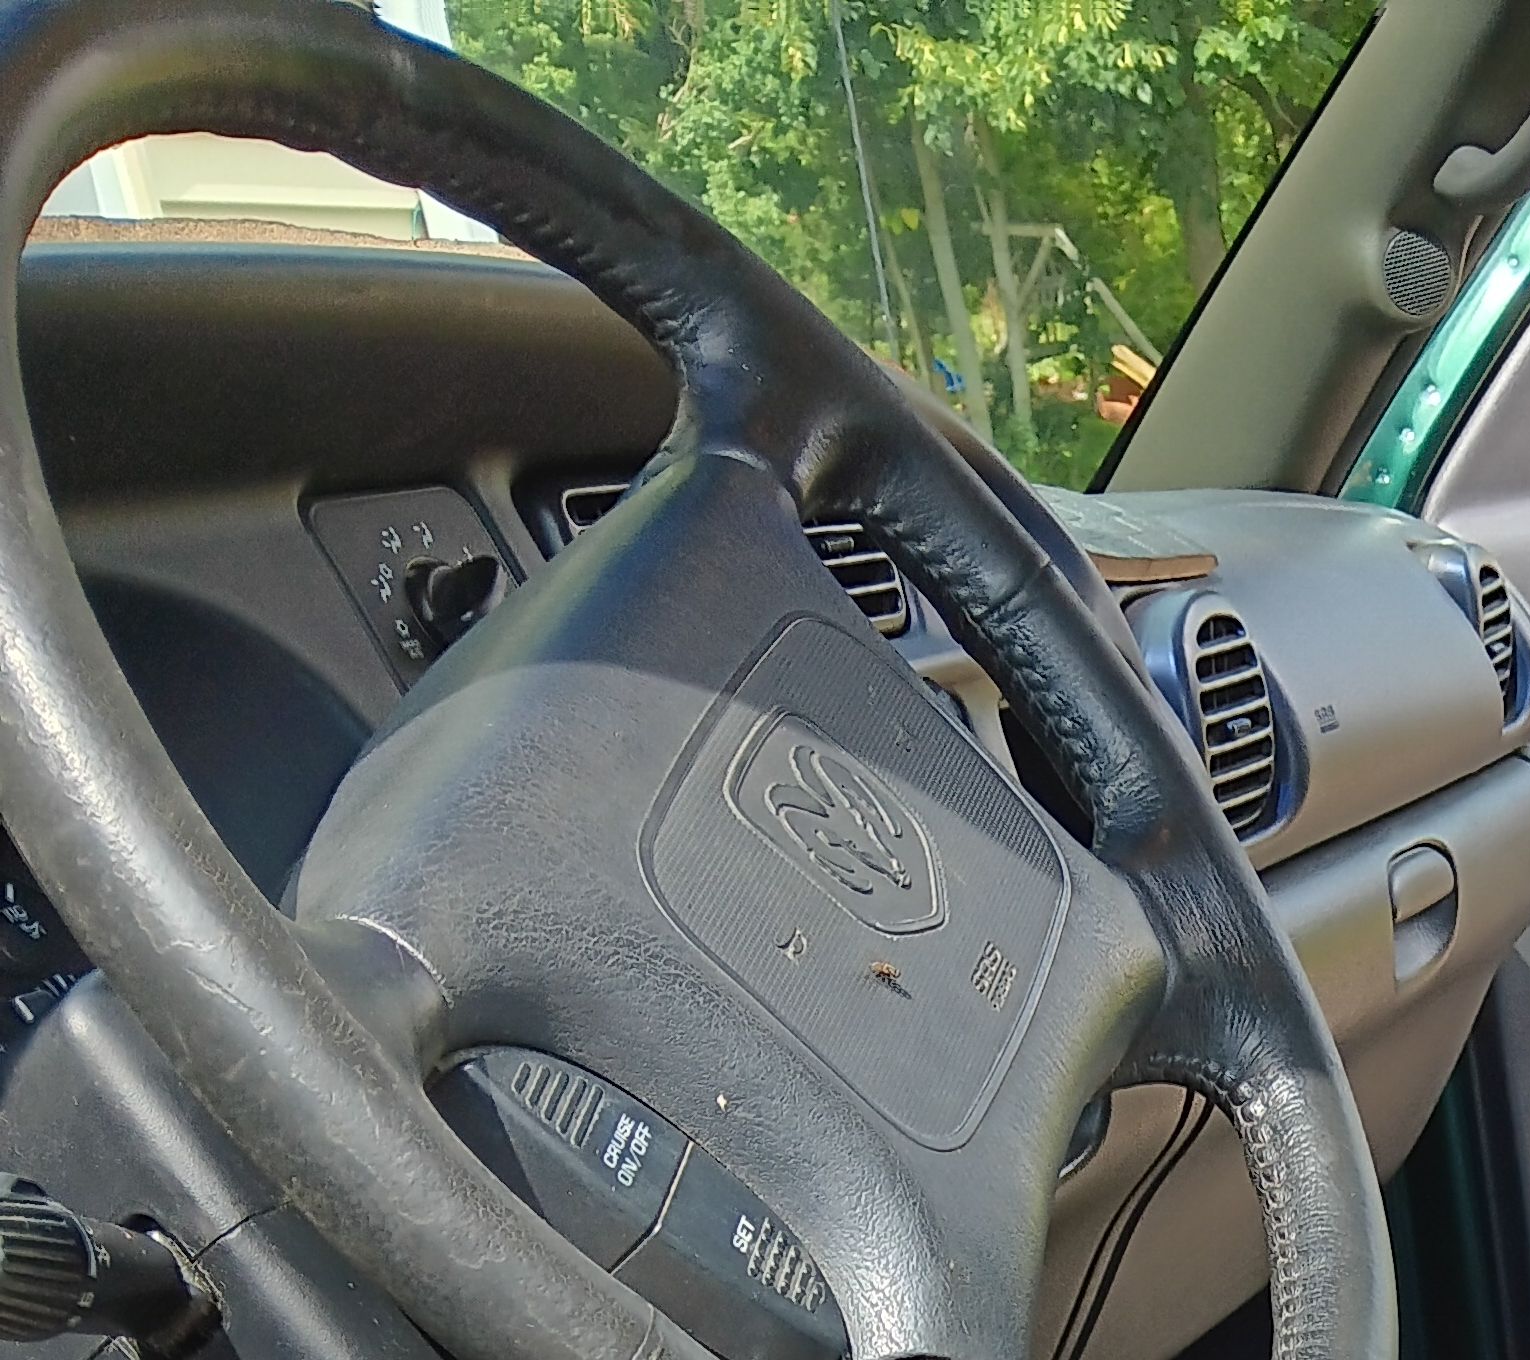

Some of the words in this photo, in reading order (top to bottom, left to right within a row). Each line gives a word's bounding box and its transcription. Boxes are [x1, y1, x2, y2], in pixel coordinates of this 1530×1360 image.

[603, 1113, 635, 1169] CRUISE
[617, 1121, 652, 1187] ON/OFF
[732, 1214, 755, 1253] SET
